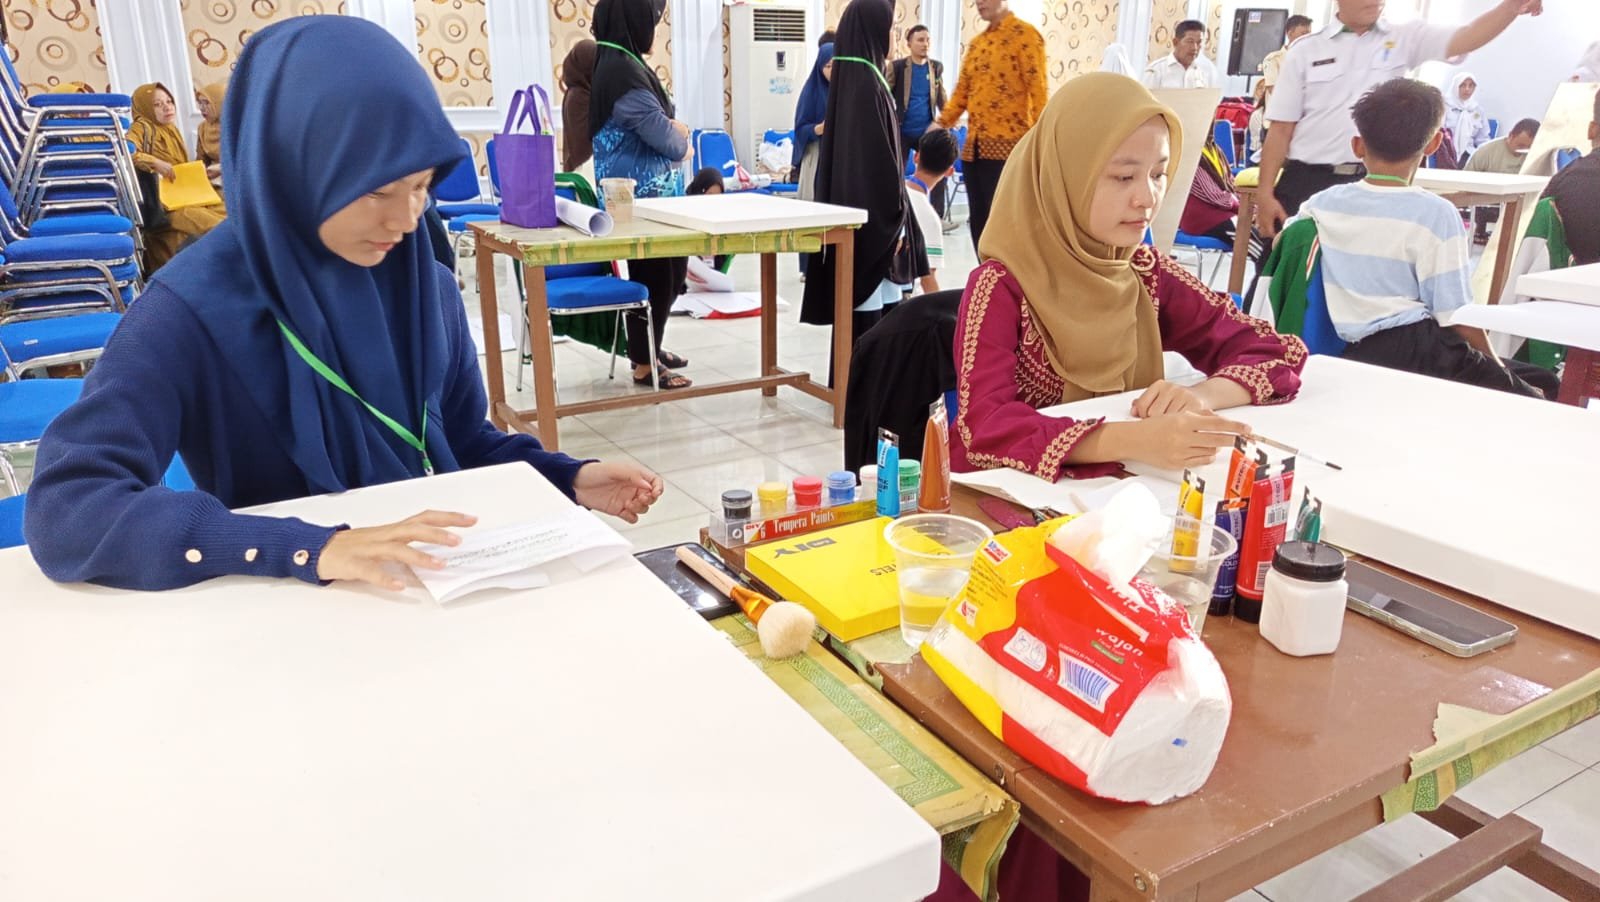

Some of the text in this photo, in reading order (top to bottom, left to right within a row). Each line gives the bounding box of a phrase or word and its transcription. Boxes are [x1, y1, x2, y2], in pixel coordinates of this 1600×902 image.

[773, 516, 808, 534] Tempera
[810, 511, 835, 526] Paints
[773, 537, 837, 559] DIY
